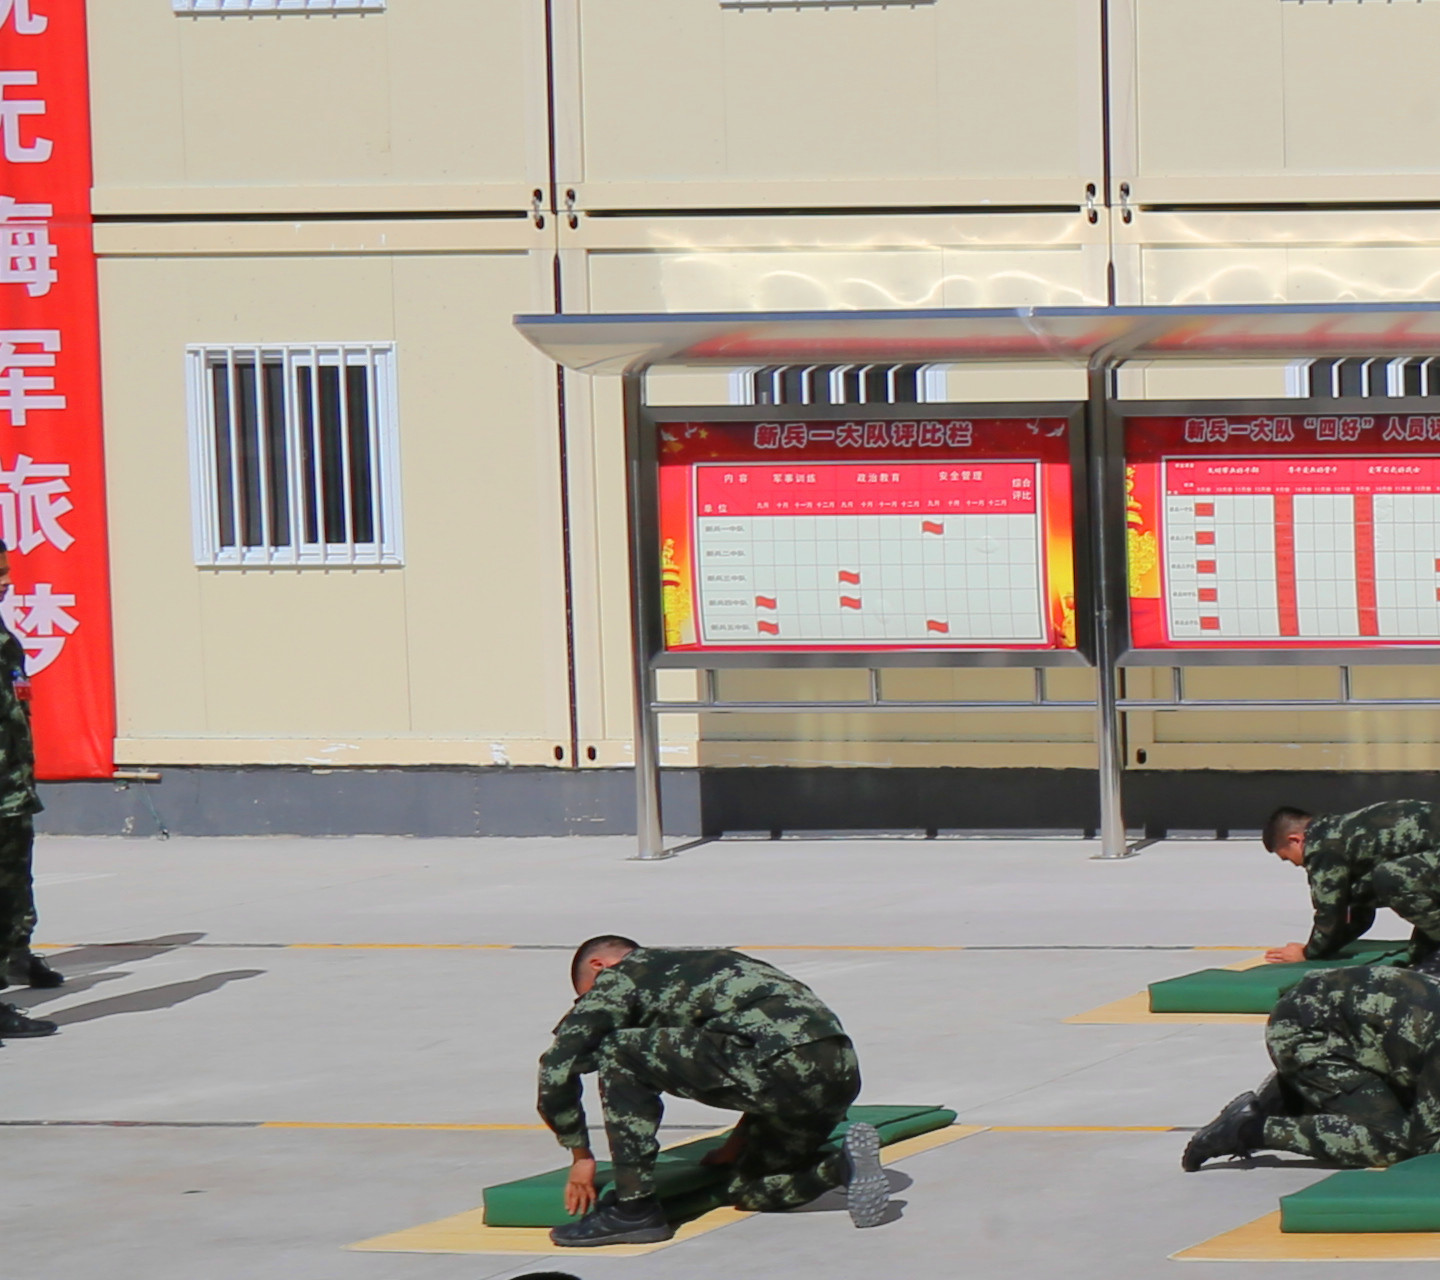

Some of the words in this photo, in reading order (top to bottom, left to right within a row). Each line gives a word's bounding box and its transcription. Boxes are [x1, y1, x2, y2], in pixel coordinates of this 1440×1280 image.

[754, 421, 973, 448] 新兵一大队评比栏
